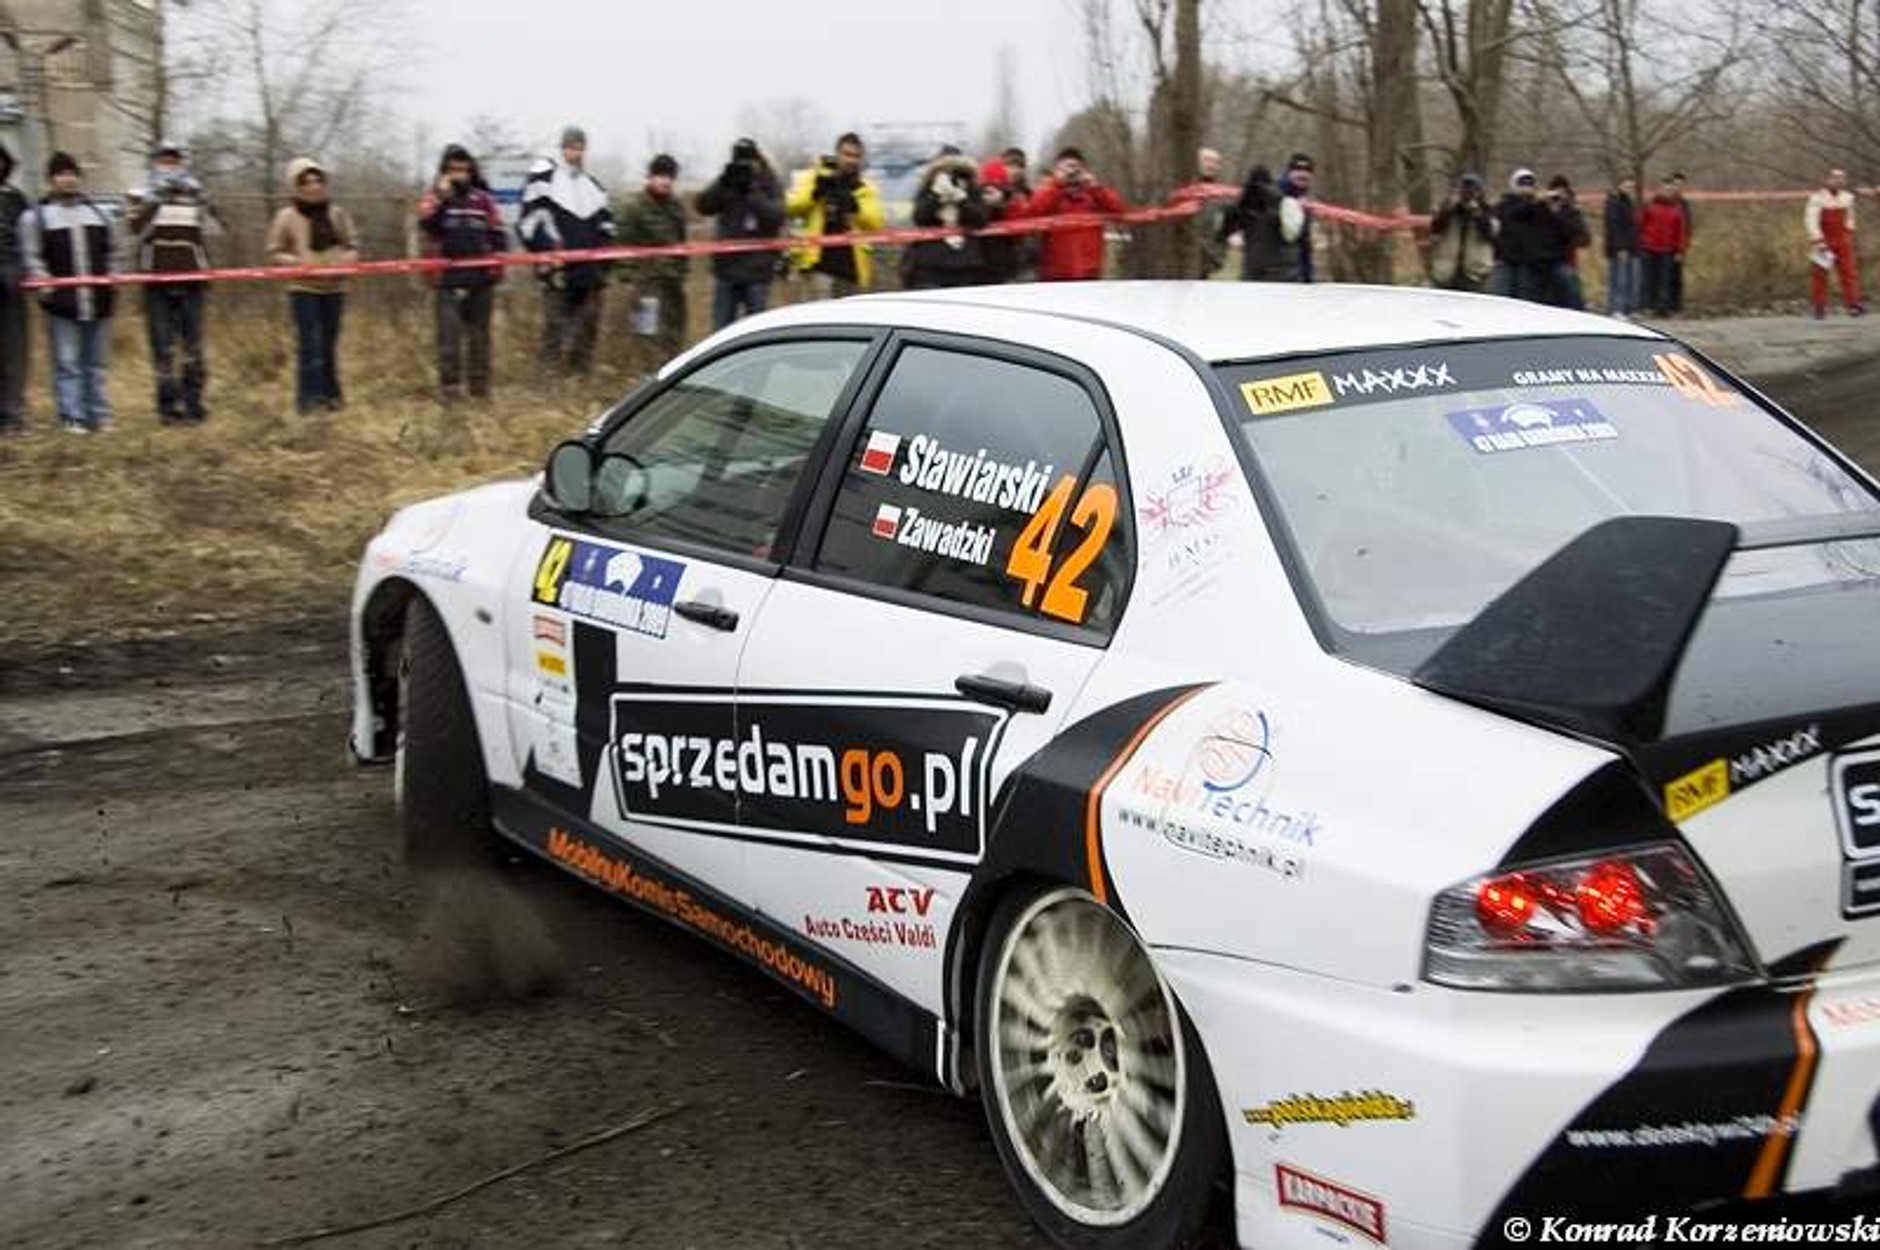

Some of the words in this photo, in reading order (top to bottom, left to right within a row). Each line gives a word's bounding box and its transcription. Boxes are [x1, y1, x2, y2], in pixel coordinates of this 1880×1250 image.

[1251, 379, 1318, 407] RMF
[1332, 363, 1457, 395] MAXXX
[1512, 369, 1575, 385] GRAMY
[1577, 368, 1603, 382] NA
[1652, 353, 1738, 412] 42
[898, 507, 996, 565] Zawadzki
[1006, 473, 1119, 623] 42
[620, 723, 978, 833] sprzedamgo.pl
[805, 914, 840, 938] Auto
[865, 886, 934, 916] ACV
